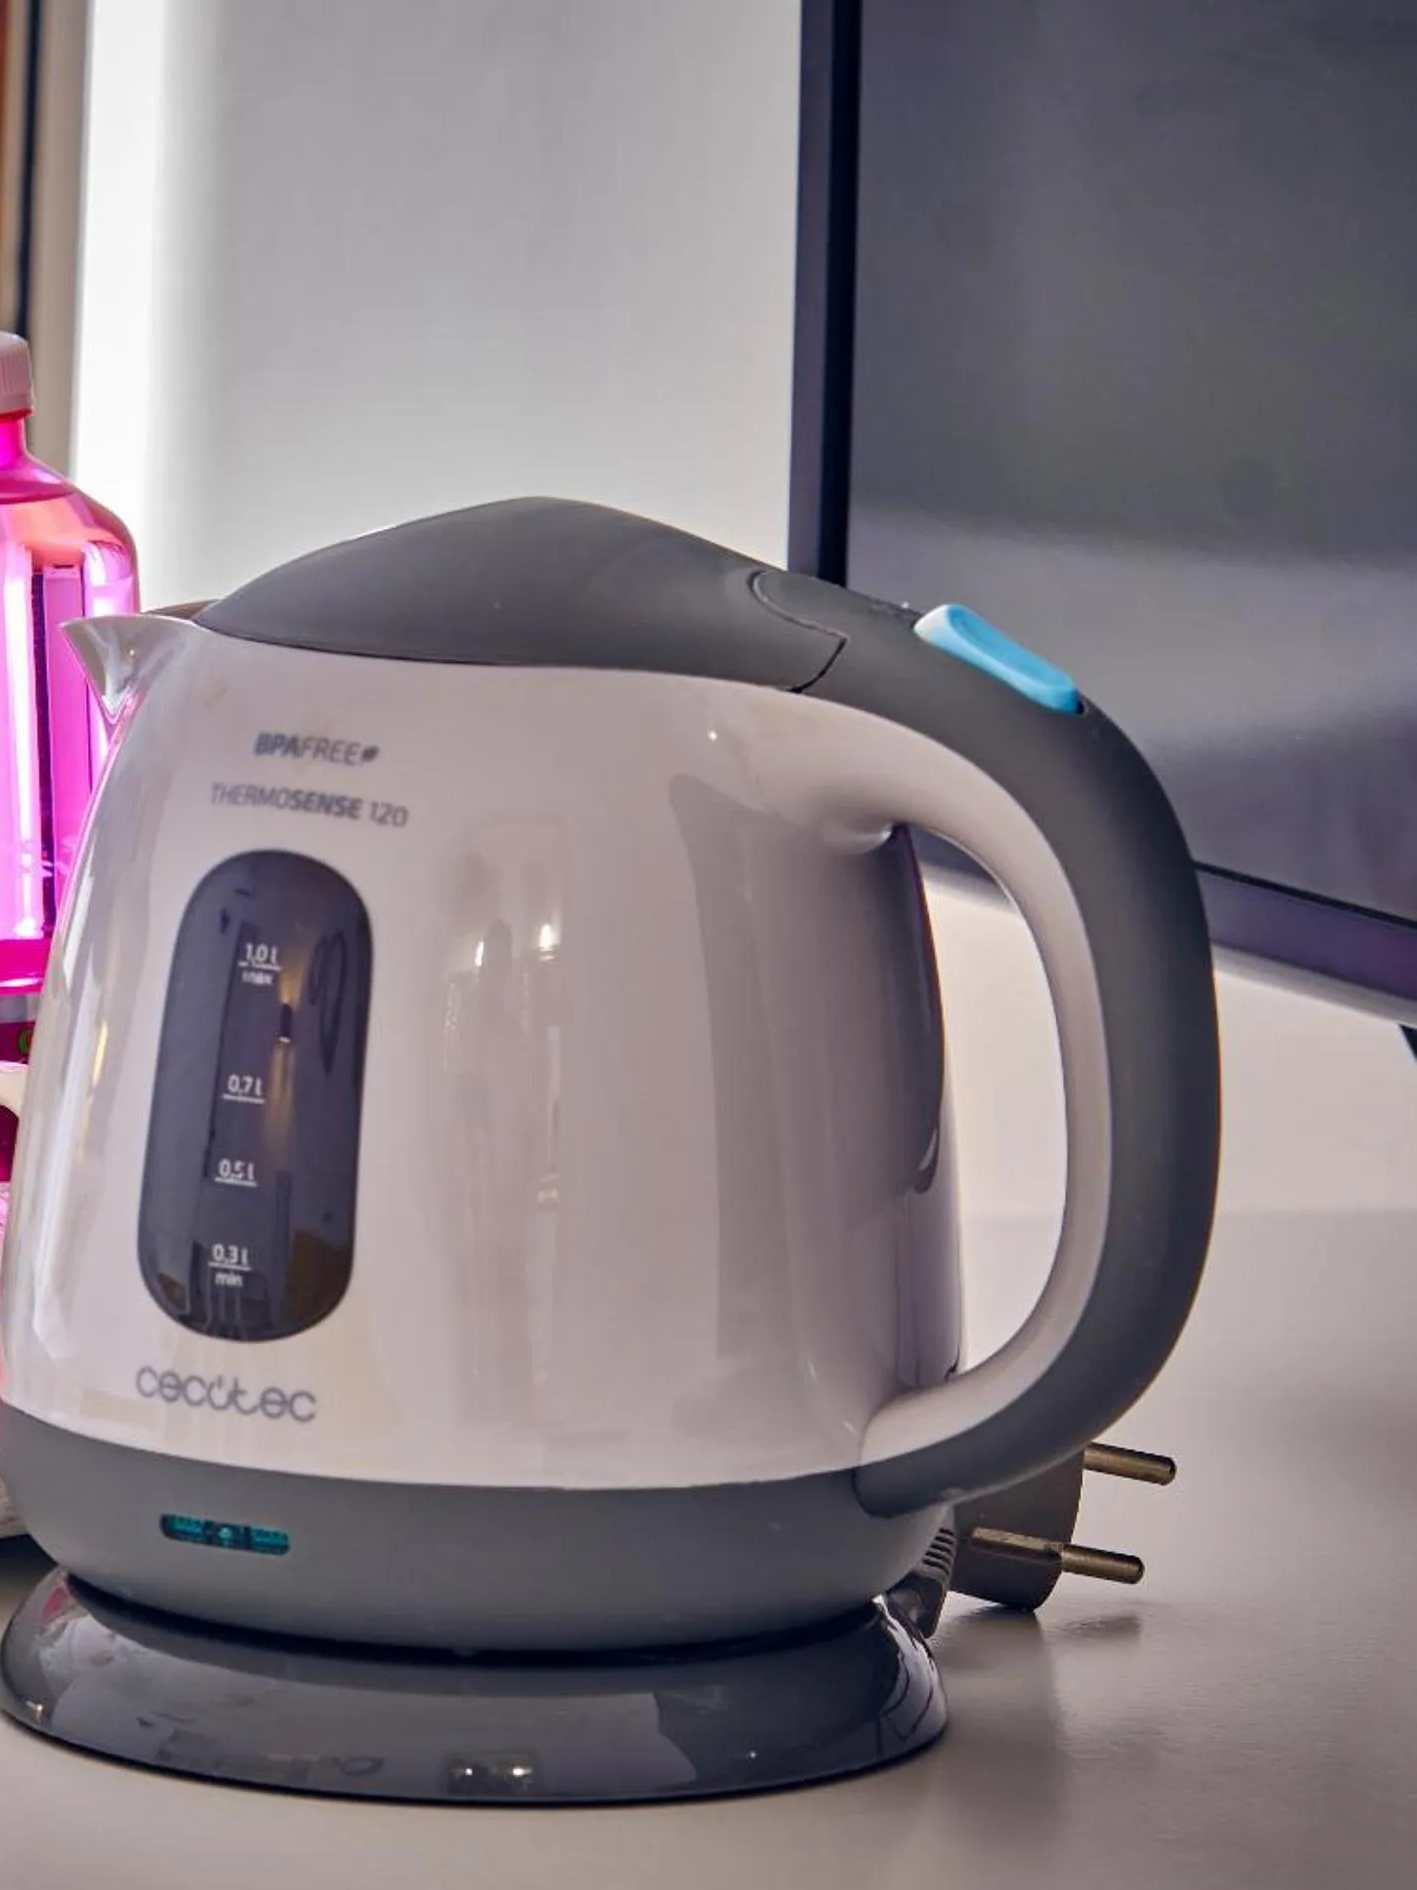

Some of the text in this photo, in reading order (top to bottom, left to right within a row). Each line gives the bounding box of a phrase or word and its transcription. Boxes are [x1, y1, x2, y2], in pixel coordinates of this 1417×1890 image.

[212, 782, 409, 828] THERMOSENSE 120
[214, 1271, 243, 1286] min
